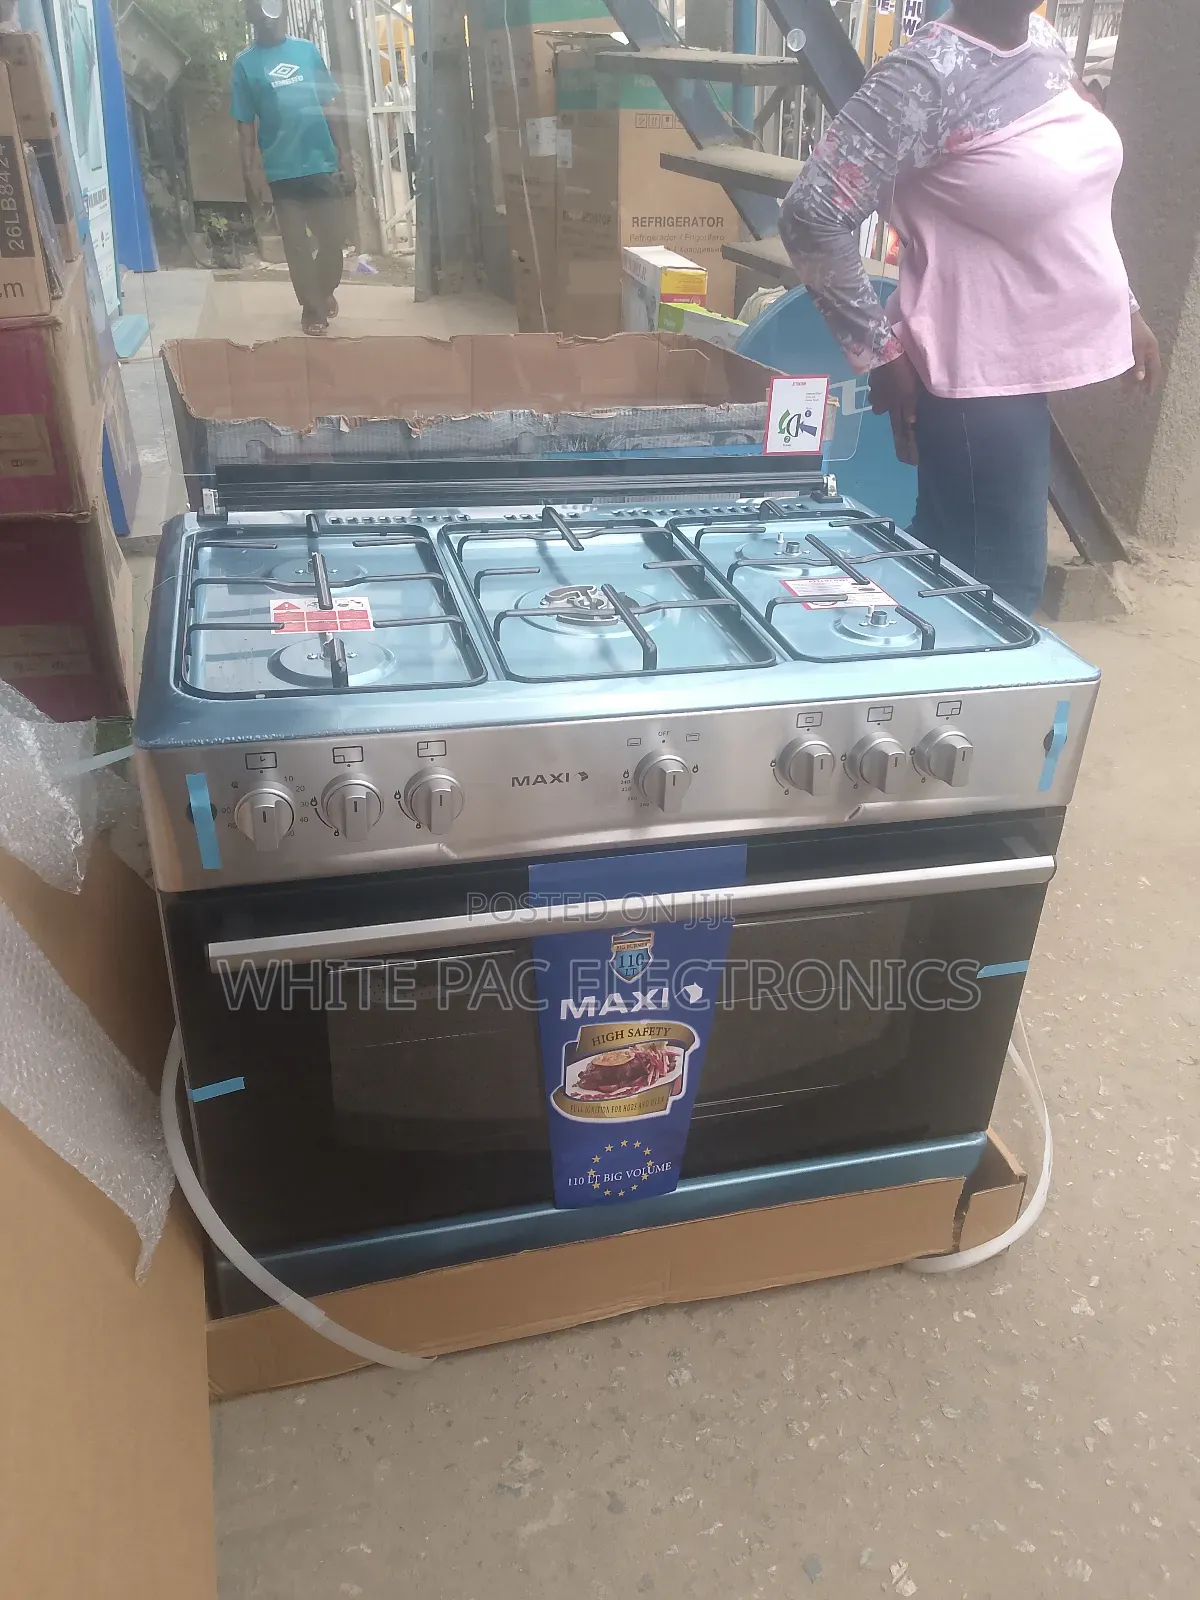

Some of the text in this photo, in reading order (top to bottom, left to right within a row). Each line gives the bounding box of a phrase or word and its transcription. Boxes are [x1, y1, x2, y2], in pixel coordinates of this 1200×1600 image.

[632, 216, 724, 228] REFRIGERATOR
[511, 772, 570, 788] MAXI
[296, 785, 306, 793] 20
[619, 953, 645, 969] 110
[625, 967, 637, 977] LT
[560, 988, 669, 1020] MAXI
[592, 1027, 671, 1047] HIGH SAFETY
[568, 1162, 672, 1186] 110 LT BIG VOLUME
